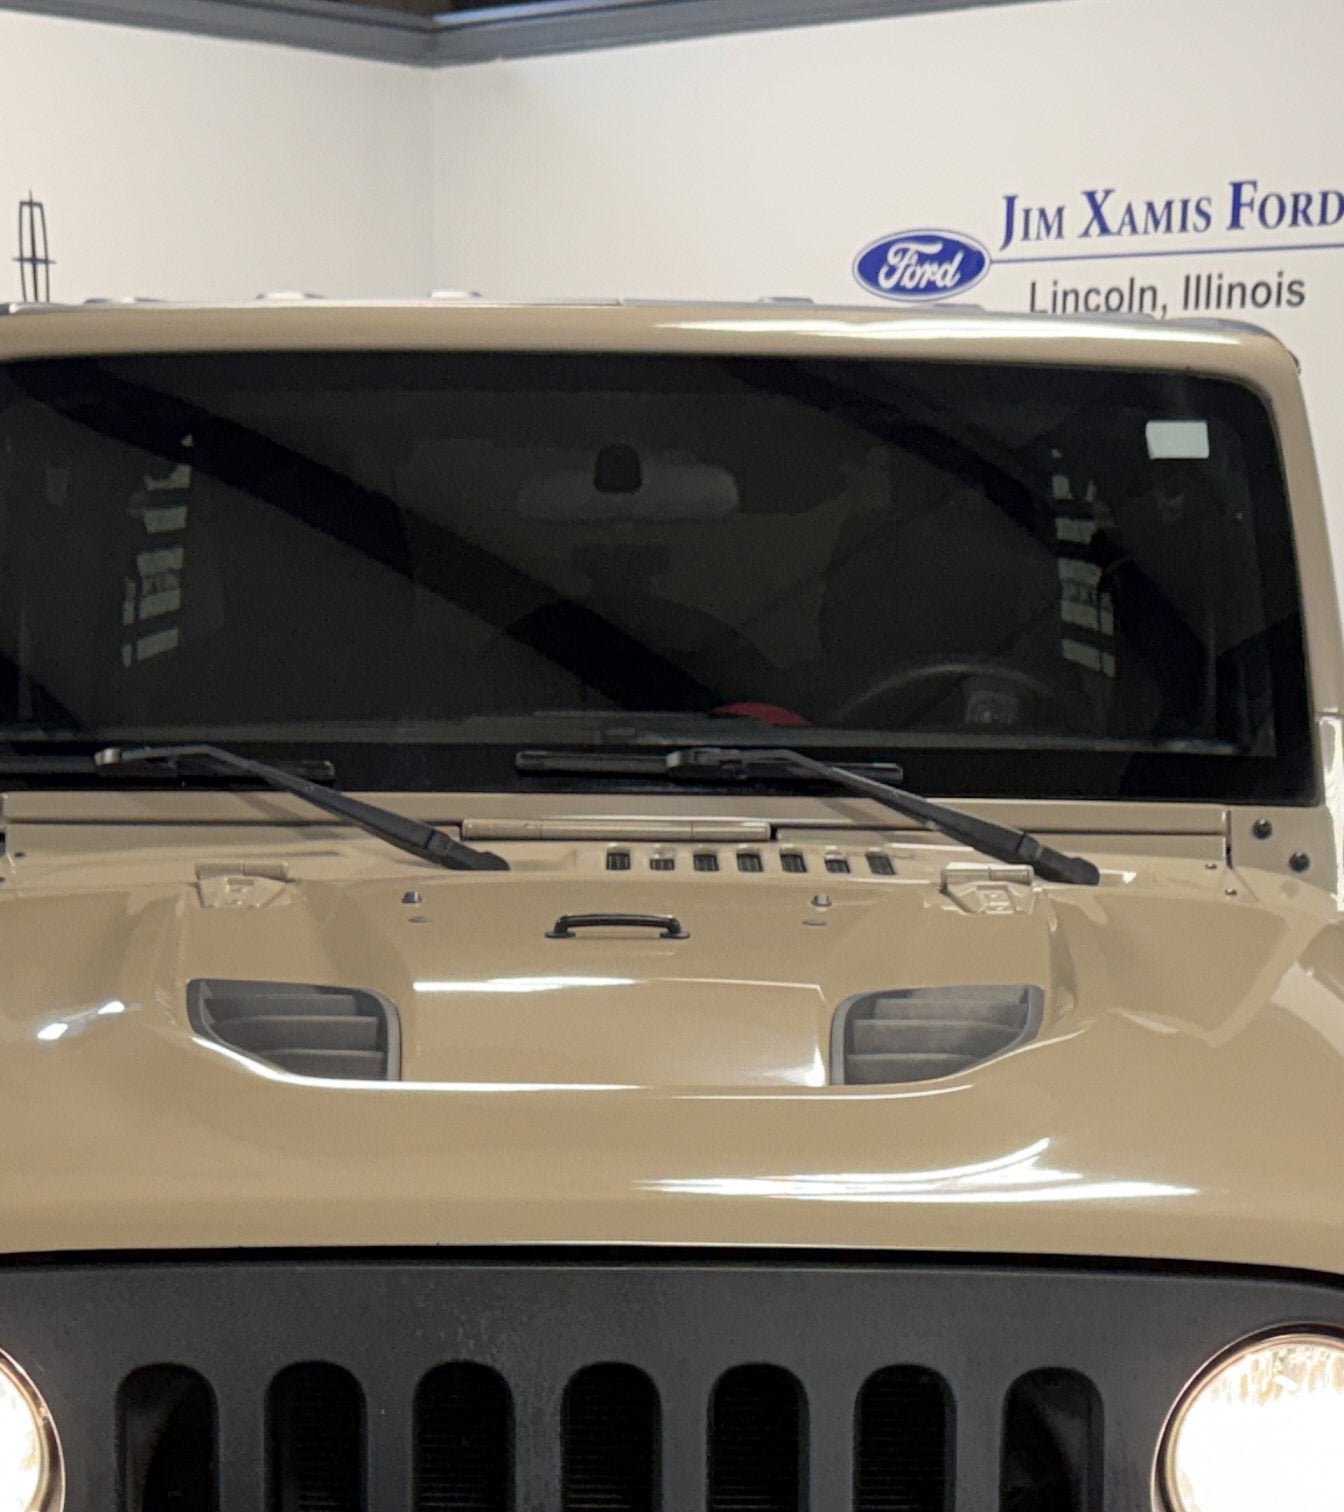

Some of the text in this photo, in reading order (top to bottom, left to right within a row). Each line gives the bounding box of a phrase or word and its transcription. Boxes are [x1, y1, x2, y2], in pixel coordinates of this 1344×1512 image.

[999, 194, 1065, 252] JIM
[1078, 188, 1212, 239] XAMIS
[877, 240, 963, 290] Ford
[1029, 270, 1306, 320] Lincoln, Illinois
